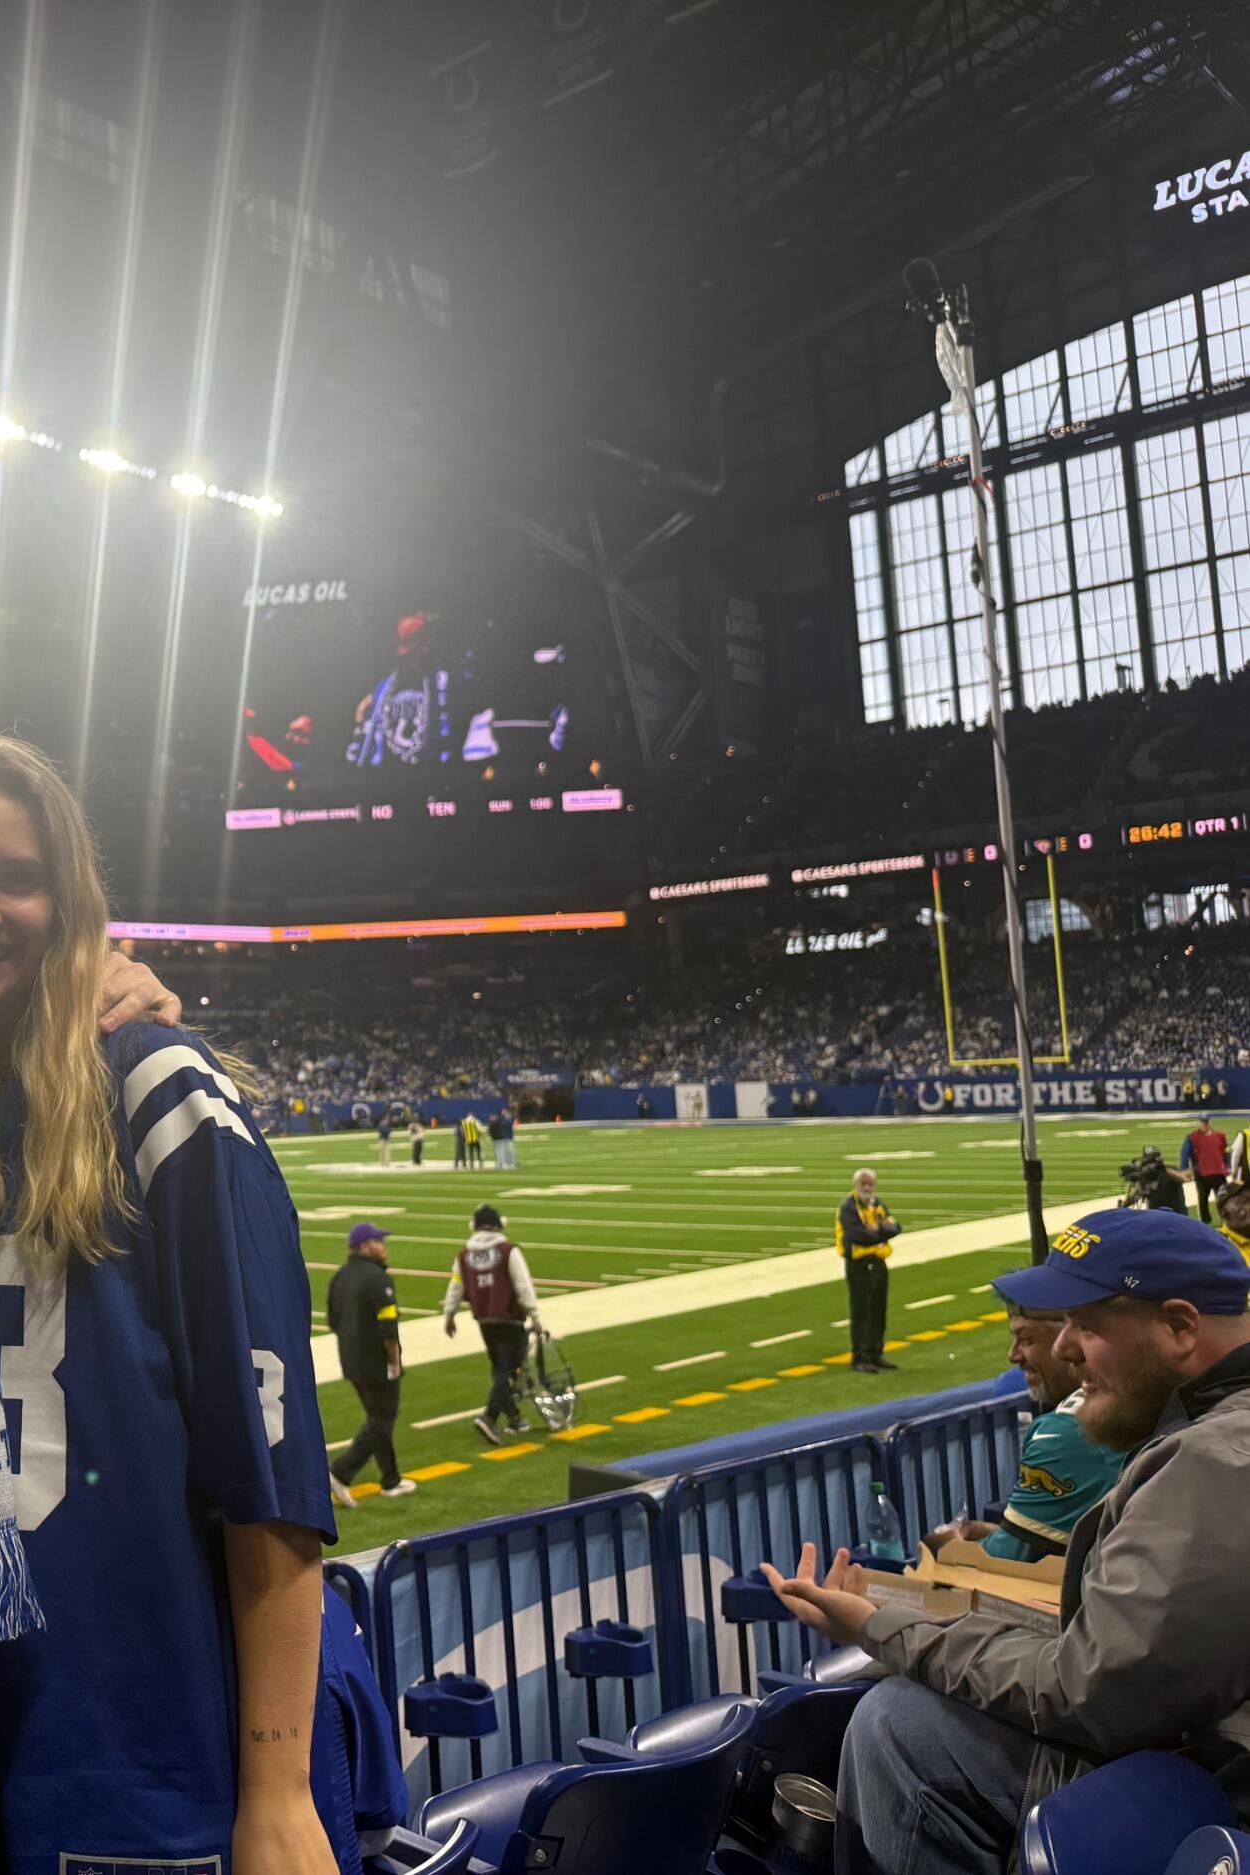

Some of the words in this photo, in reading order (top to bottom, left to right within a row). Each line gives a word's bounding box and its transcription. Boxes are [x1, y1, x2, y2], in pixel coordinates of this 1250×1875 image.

[1191, 190, 1249, 223] STA
[242, 582, 310, 606] LUCAS
[313, 580, 348, 602] OIL
[1195, 818, 1226, 836] QTR
[1230, 816, 1239, 830] 1
[803, 863, 858, 881] CAESARS
[660, 881, 710, 899] CAESARS
[952, 1083, 1016, 1107] FOR
[1029, 1080, 1096, 1106] THE
